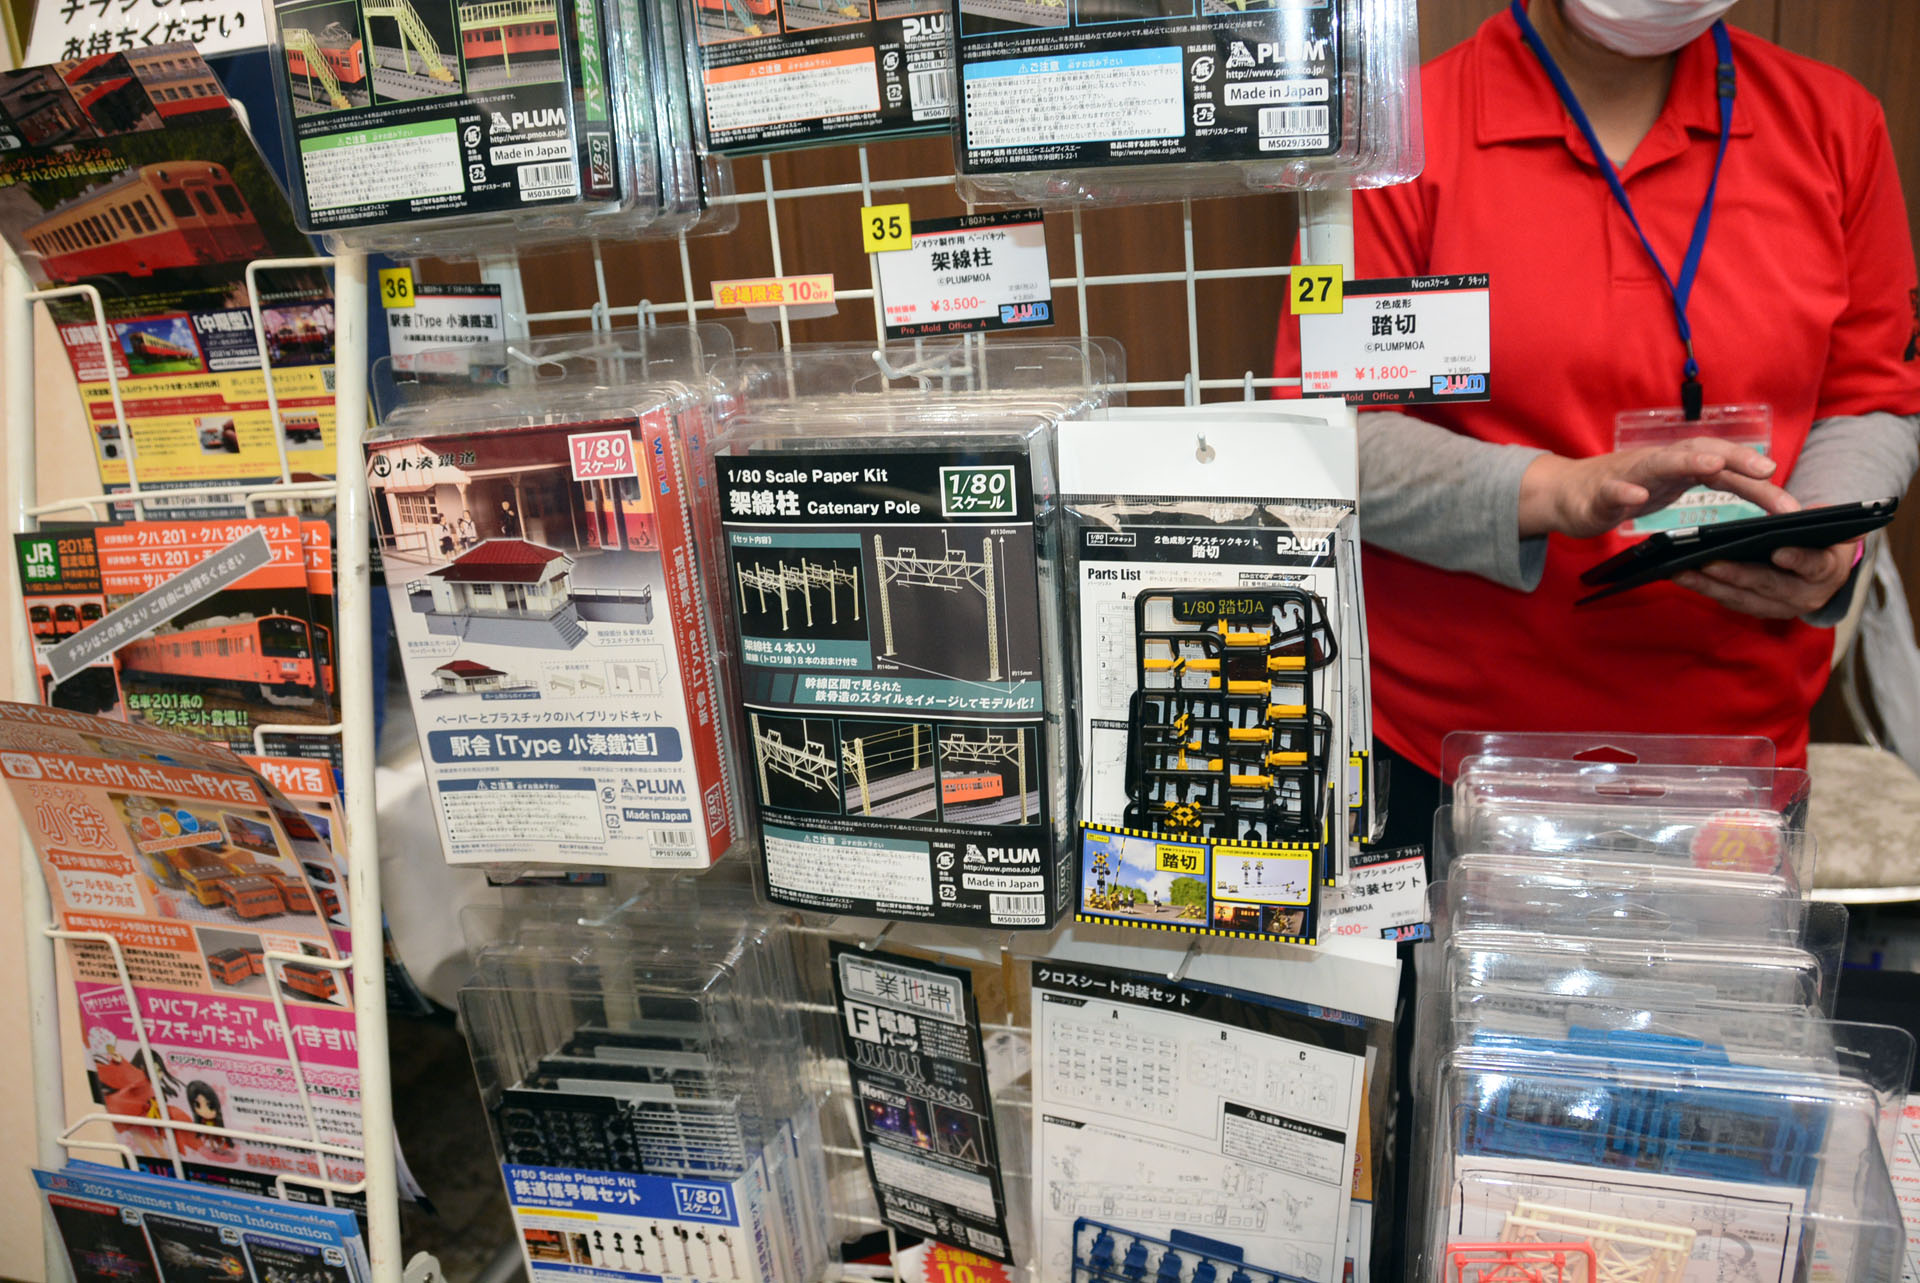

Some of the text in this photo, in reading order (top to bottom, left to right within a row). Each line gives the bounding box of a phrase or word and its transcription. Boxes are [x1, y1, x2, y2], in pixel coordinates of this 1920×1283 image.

[60, 11, 246, 61] お持ちください
[913, 62, 933, 70] MADE
[1030, 61, 1060, 73] ご注意
[1230, 84, 1323, 100] Made in Japan
[511, 107, 567, 130] PLUM
[1267, 138, 1323, 149] MS029/3500
[494, 145, 567, 161] Made in Japan
[527, 187, 571, 199] MS038/3500
[871, 215, 903, 241] 35
[913, 236, 965, 249] ジオラマ製作用
[931, 247, 993, 272] 架線柱
[386, 277, 408, 299] 36
[718, 284, 785, 304] 会場限定
[788, 281, 811, 302] 10
[812, 289, 829, 300] OFF
[1298, 276, 1333, 302] 27
[1411, 278, 1450, 289] Nonスケール
[1375, 298, 1412, 310] 2色成形
[390, 313, 414, 328] 駅舎
[1000, 302, 1050, 325] PLUM
[920, 323, 942, 333] Mold
[948, 321, 973, 331] Office
[979, 320, 987, 328] A
[1371, 314, 1416, 336] 踏切
[1304, 370, 1339, 381] 特別価格
[1431, 374, 1486, 396] PLUM
[1341, 390, 1415, 401] Mold Office A
[576, 437, 626, 460] 1/80
[396, 451, 477, 472] 小湊鐵道
[580, 457, 627, 474] スケール
[653, 436, 670, 496] PLUM
[727, 467, 889, 485] 1/80 Scale Paper Kit
[949, 473, 1006, 495] 1/80
[729, 489, 801, 517] 架線柱
[807, 499, 921, 517] Catenary Pole
[950, 495, 1006, 511] スケール
[1679, 509, 1720, 524] 2022
[58, 538, 94, 554] 201系
[1154, 535, 1260, 547] 2色成形プラスチックキット
[1276, 535, 1330, 556] PLUM
[26, 543, 54, 565] JR
[1192, 545, 1220, 559] 踏切
[27, 565, 56, 578] 東日本
[1087, 567, 1118, 581] Parts
[1120, 568, 1141, 581] List
[149, 552, 247, 614] ご自由にお持ちください
[1121, 591, 1127, 600] A
[1183, 598, 1265, 615] 1/80 踏切A
[743, 639, 817, 655] 架線柱4本入り
[804, 677, 902, 693] 幹線区間で見られた
[129, 694, 203, 710] 名車201系の
[815, 690, 1035, 711] 鉄骨造のスタイルをイメージしてモデル化!
[152, 709, 249, 727] プラキット登場!!
[435, 710, 663, 725] ペーパーとプラスチックのハイブリッドキット
[450, 732, 658, 759] 駅舎 [Type 小湊鐵道]
[38, 756, 258, 803] だれでもかんたんに作れる
[260, 762, 323, 793] 作れる
[636, 779, 686, 795] PLUM
[625, 810, 689, 822] Made in Japan
[707, 794, 719, 830] 1/80
[36, 799, 116, 850] 小鉄
[812, 835, 836, 846] ご注意
[986, 846, 1041, 865] PLUM
[1162, 852, 1198, 871] 踏切
[963, 863, 1042, 875] http://www.pmoa.co.jp/
[63, 875, 134, 895] シールを貼って
[966, 877, 1040, 891] Made in Japan
[997, 916, 1041, 924] MS030/3500
[849, 965, 952, 1013] 工業地帯
[1038, 967, 1192, 1008] クロスシート内装セット
[148, 996, 259, 1027] PVCフィギュア
[1111, 1009, 1119, 1020] A
[852, 1007, 871, 1035] F
[882, 1031, 919, 1053] パーツ
[1220, 1030, 1228, 1041] B
[1299, 1050, 1307, 1062] C
[510, 1168, 637, 1188] 1/80 Scale Plastic Kit
[513, 1178, 642, 1205] 鉄道信号機セット
[678, 1187, 722, 1206] 1/80
[82, 1183, 114, 1199] 2022
[115, 1188, 173, 1210] Summer
[175, 1200, 207, 1216] New
[208, 1207, 243, 1224] Item
[244, 1213, 334, 1241] Information
[682, 1201, 722, 1215] スケール
[899, 1197, 932, 1217] PLUM
